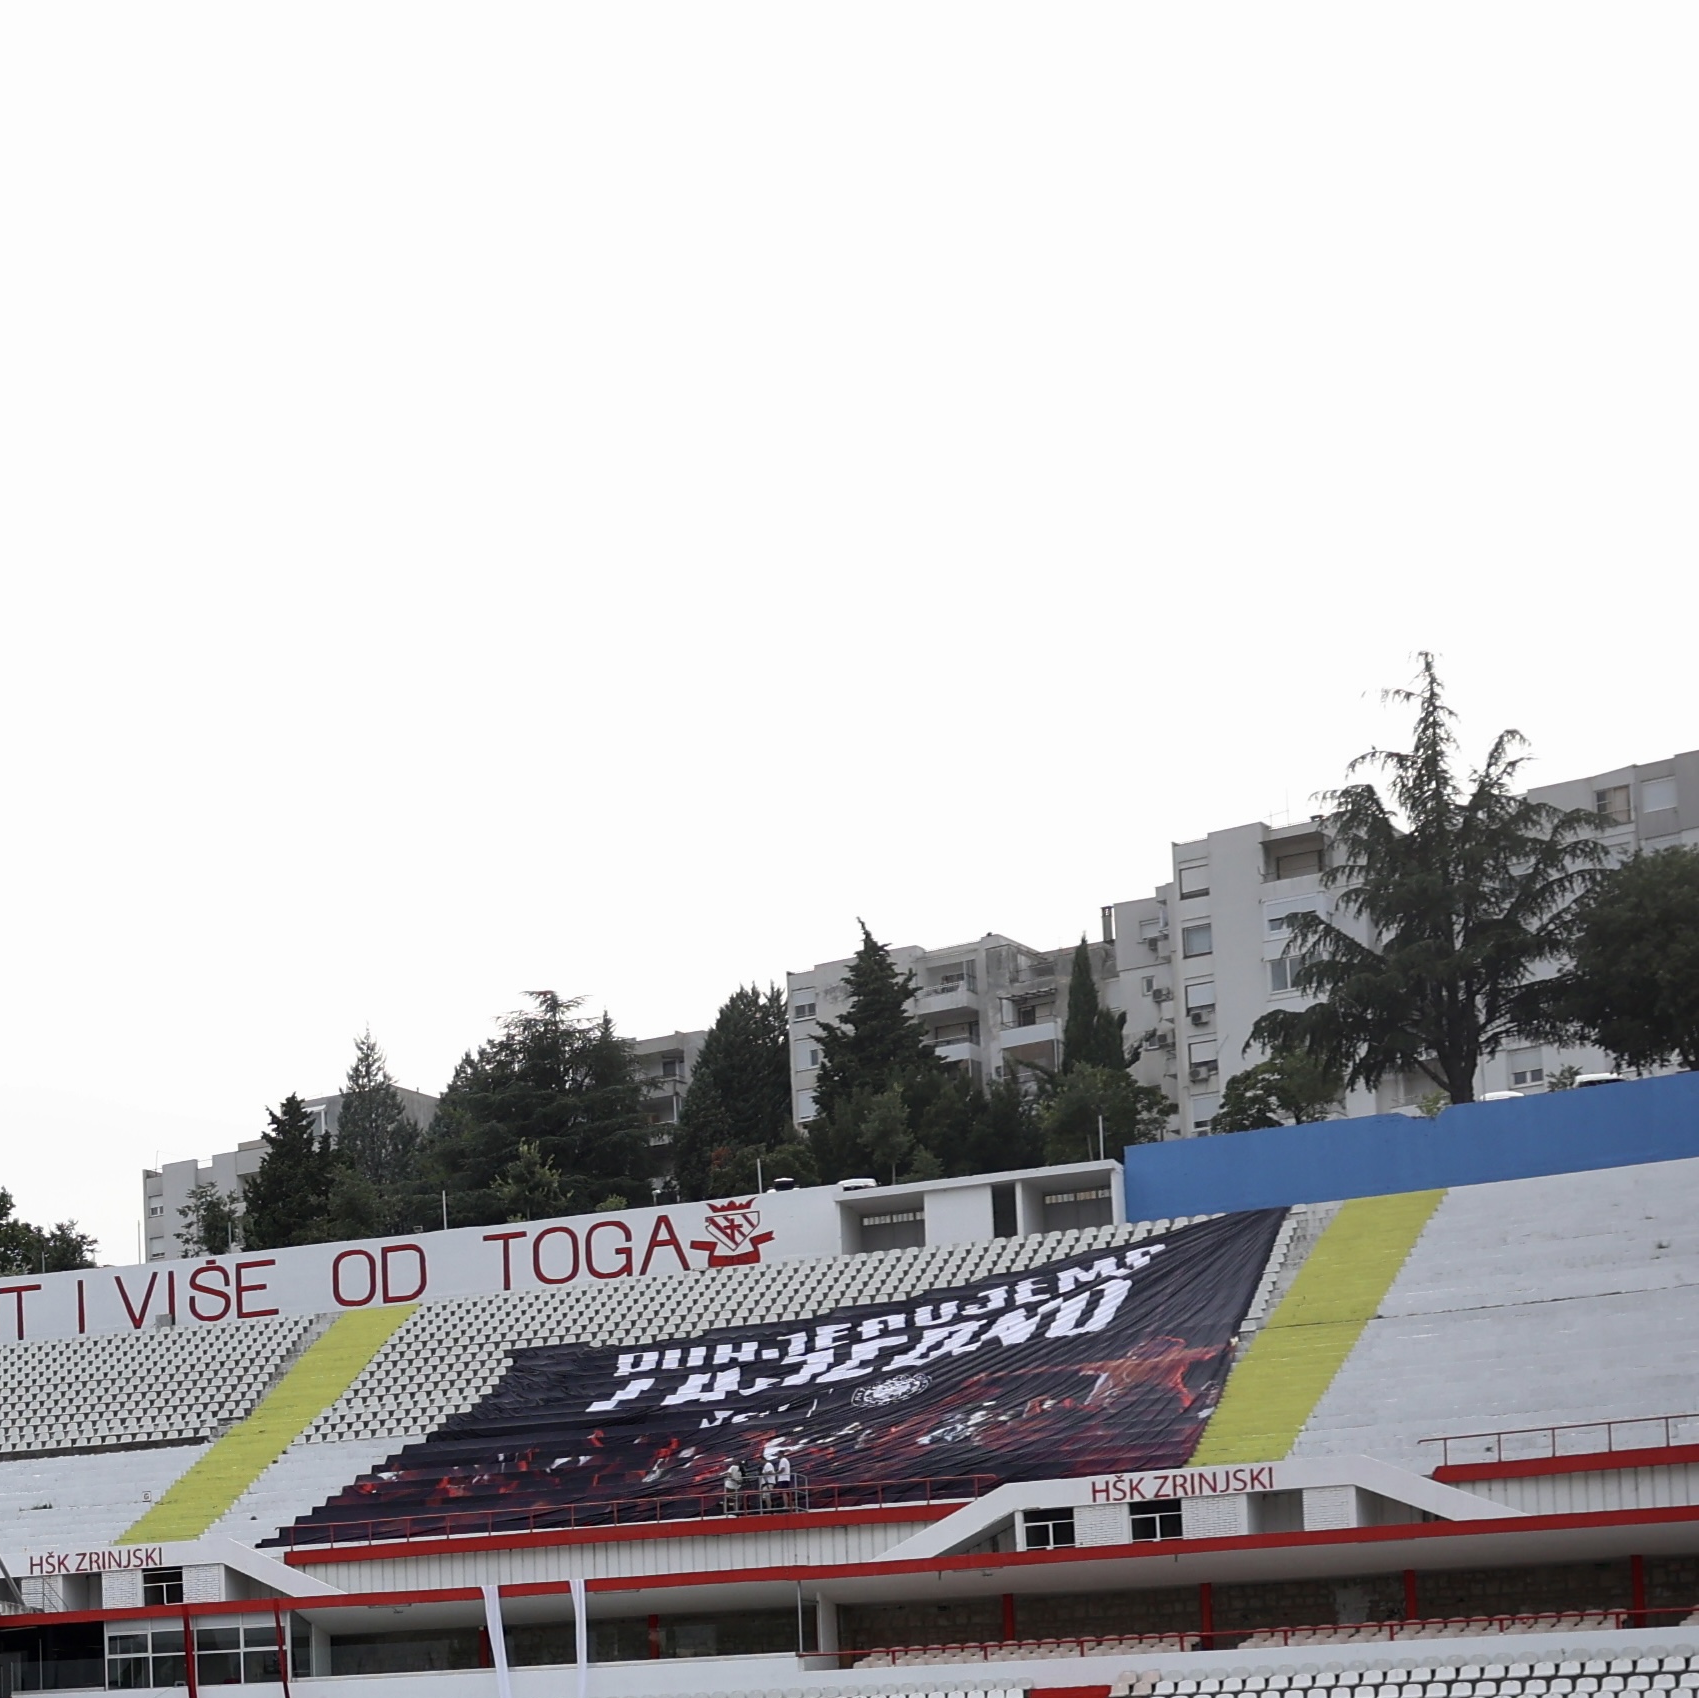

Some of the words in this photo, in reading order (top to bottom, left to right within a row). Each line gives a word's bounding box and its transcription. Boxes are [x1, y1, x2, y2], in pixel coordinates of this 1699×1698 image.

[77, 1279, 85, 1334] I
[332, 1243, 427, 1307] OD
[483, 1214, 691, 1290] TOGA
[1091, 1475, 1146, 1504] HŠK
[1153, 1466, 1275, 1499] ZRINJSKI
[30, 1551, 71, 1575] HŠK
[75, 1547, 163, 1572] ZRINJSKI
